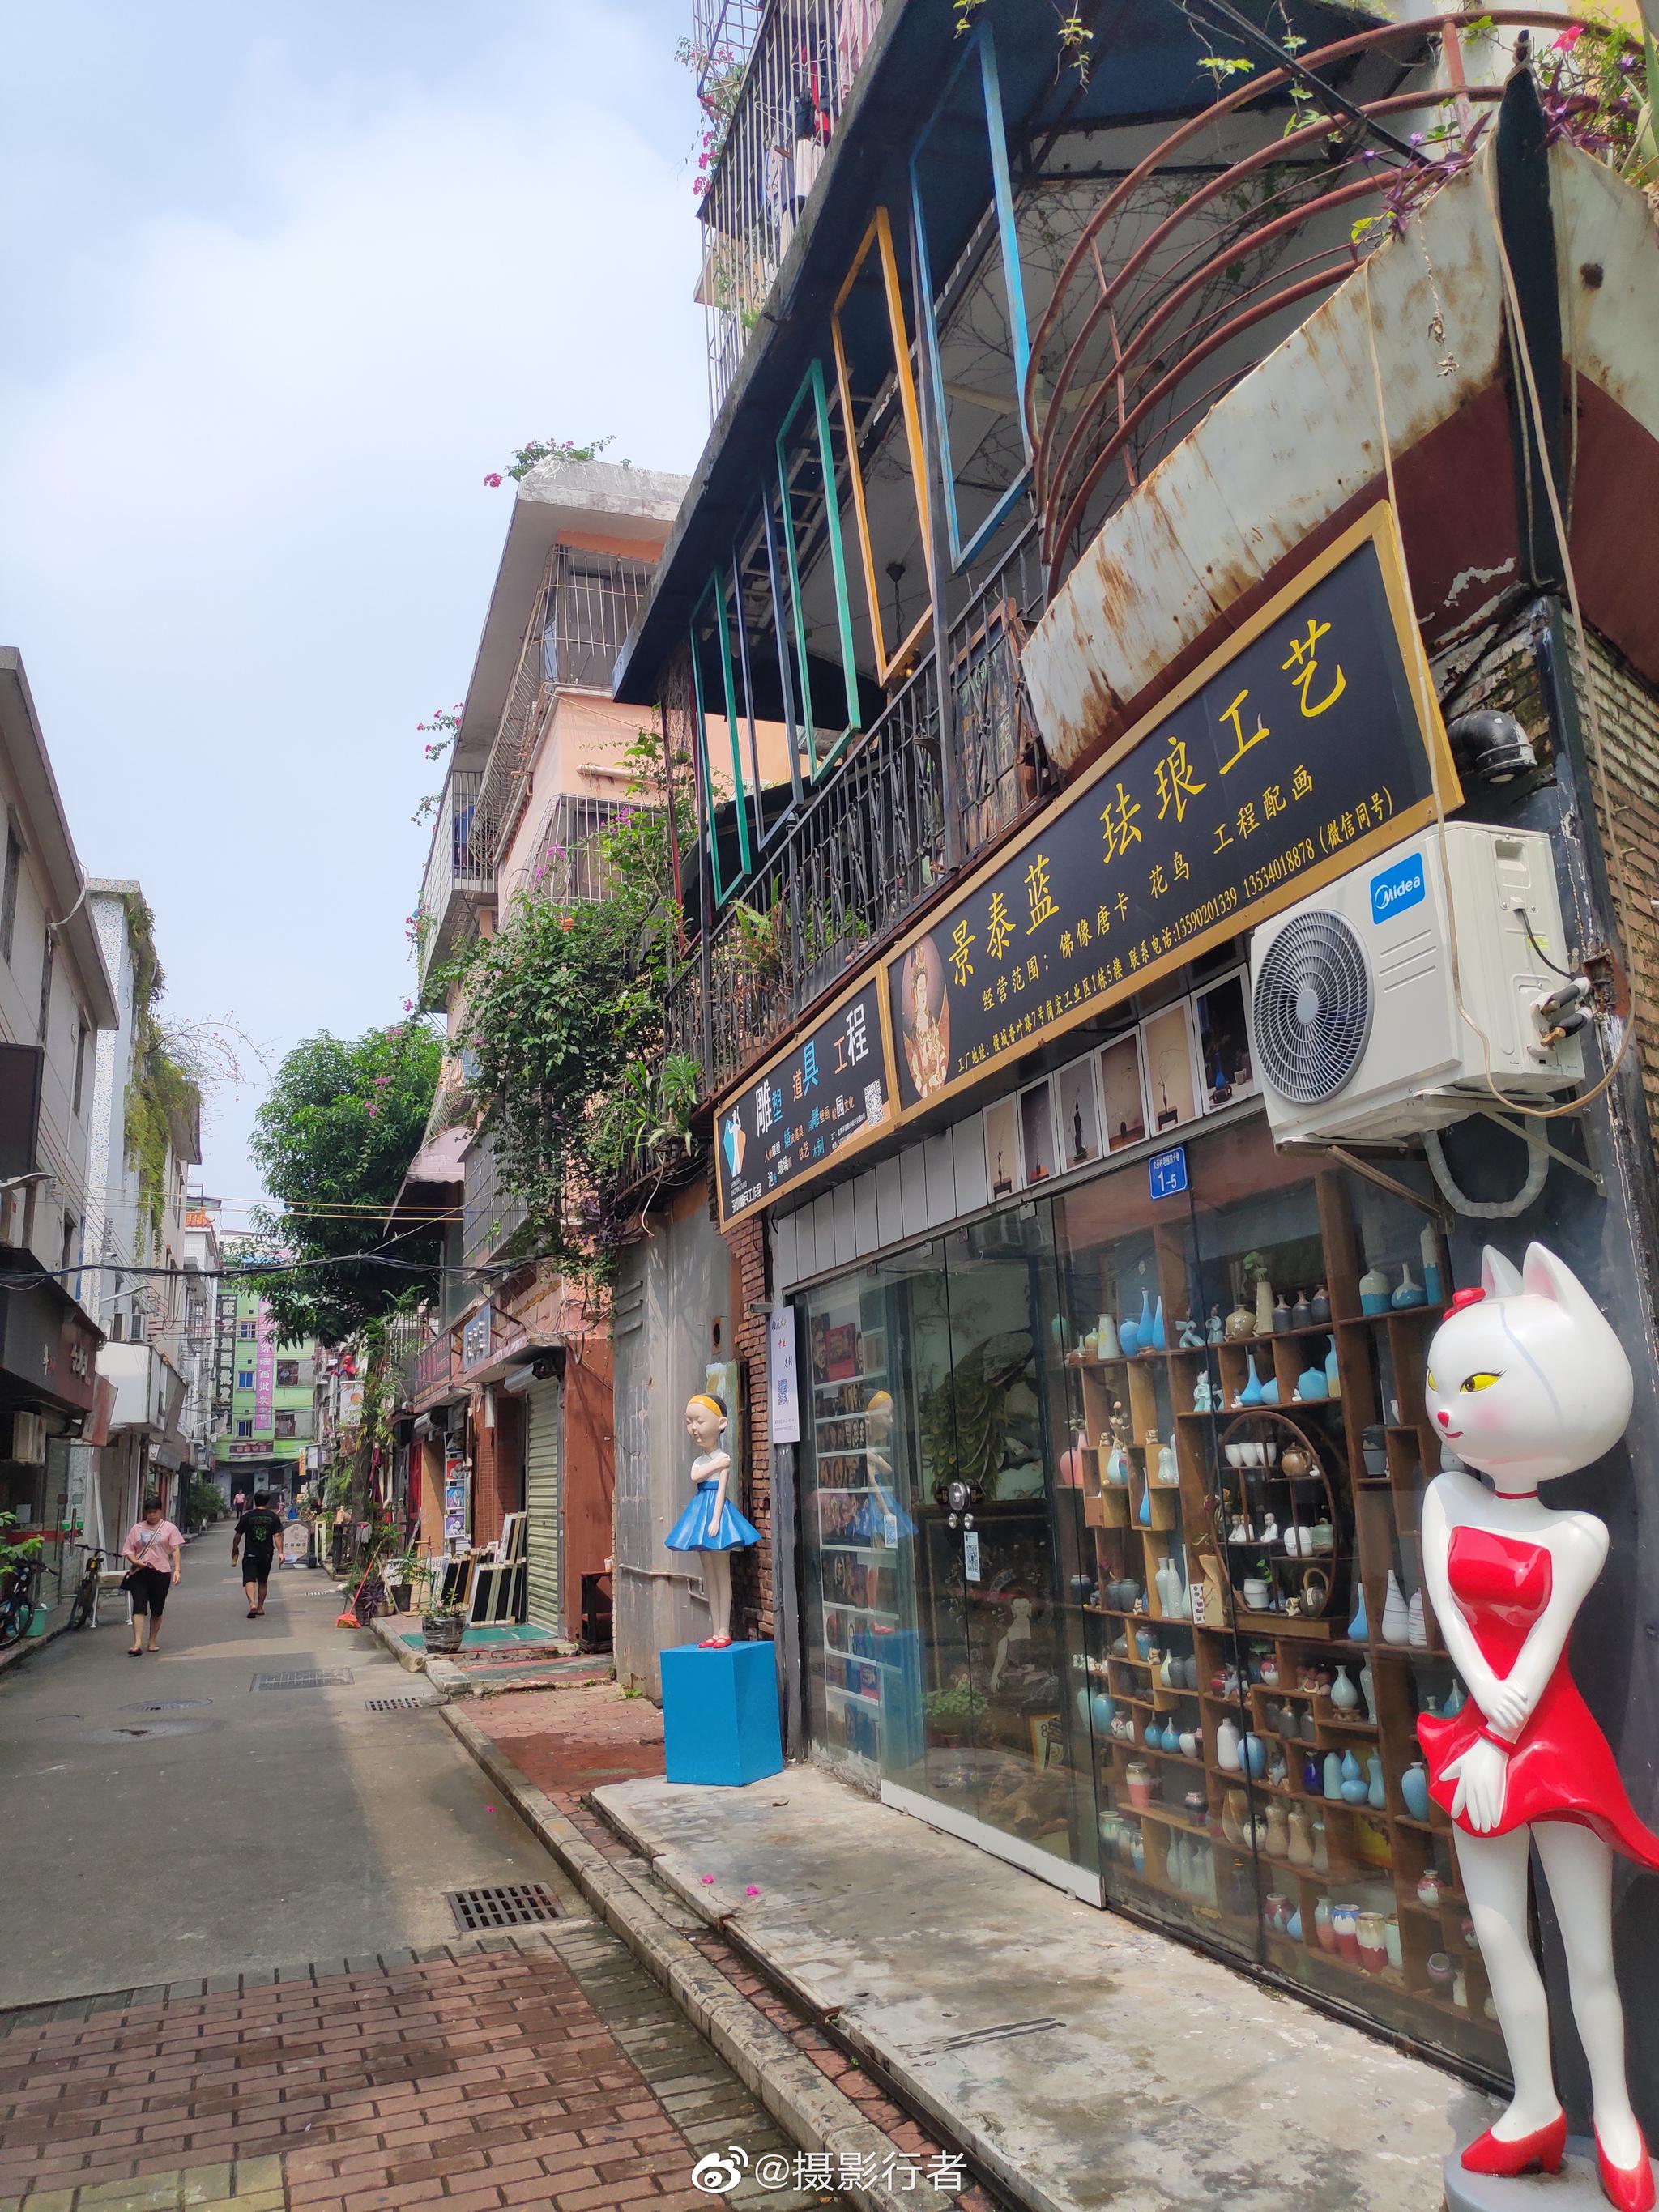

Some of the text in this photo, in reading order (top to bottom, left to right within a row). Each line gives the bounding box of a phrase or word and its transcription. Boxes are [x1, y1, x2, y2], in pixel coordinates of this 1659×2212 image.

[949, 619, 1347, 986] 景泰蓝 珐琅工艺
[1149, 852, 1191, 897] 花鸟
[1213, 764, 1314, 855] 工程配画
[1375, 876, 1421, 909] Midea
[755, 1080, 783, 1138] 雕塑
[792, 1040, 820, 1102] 道具
[834, 1003, 870, 1075] 工程
[831, 1094, 855, 1122] 校园文化
[798, 1140, 811, 1161] 铁艺
[1158, 1171, 1177, 1191] 1-5
